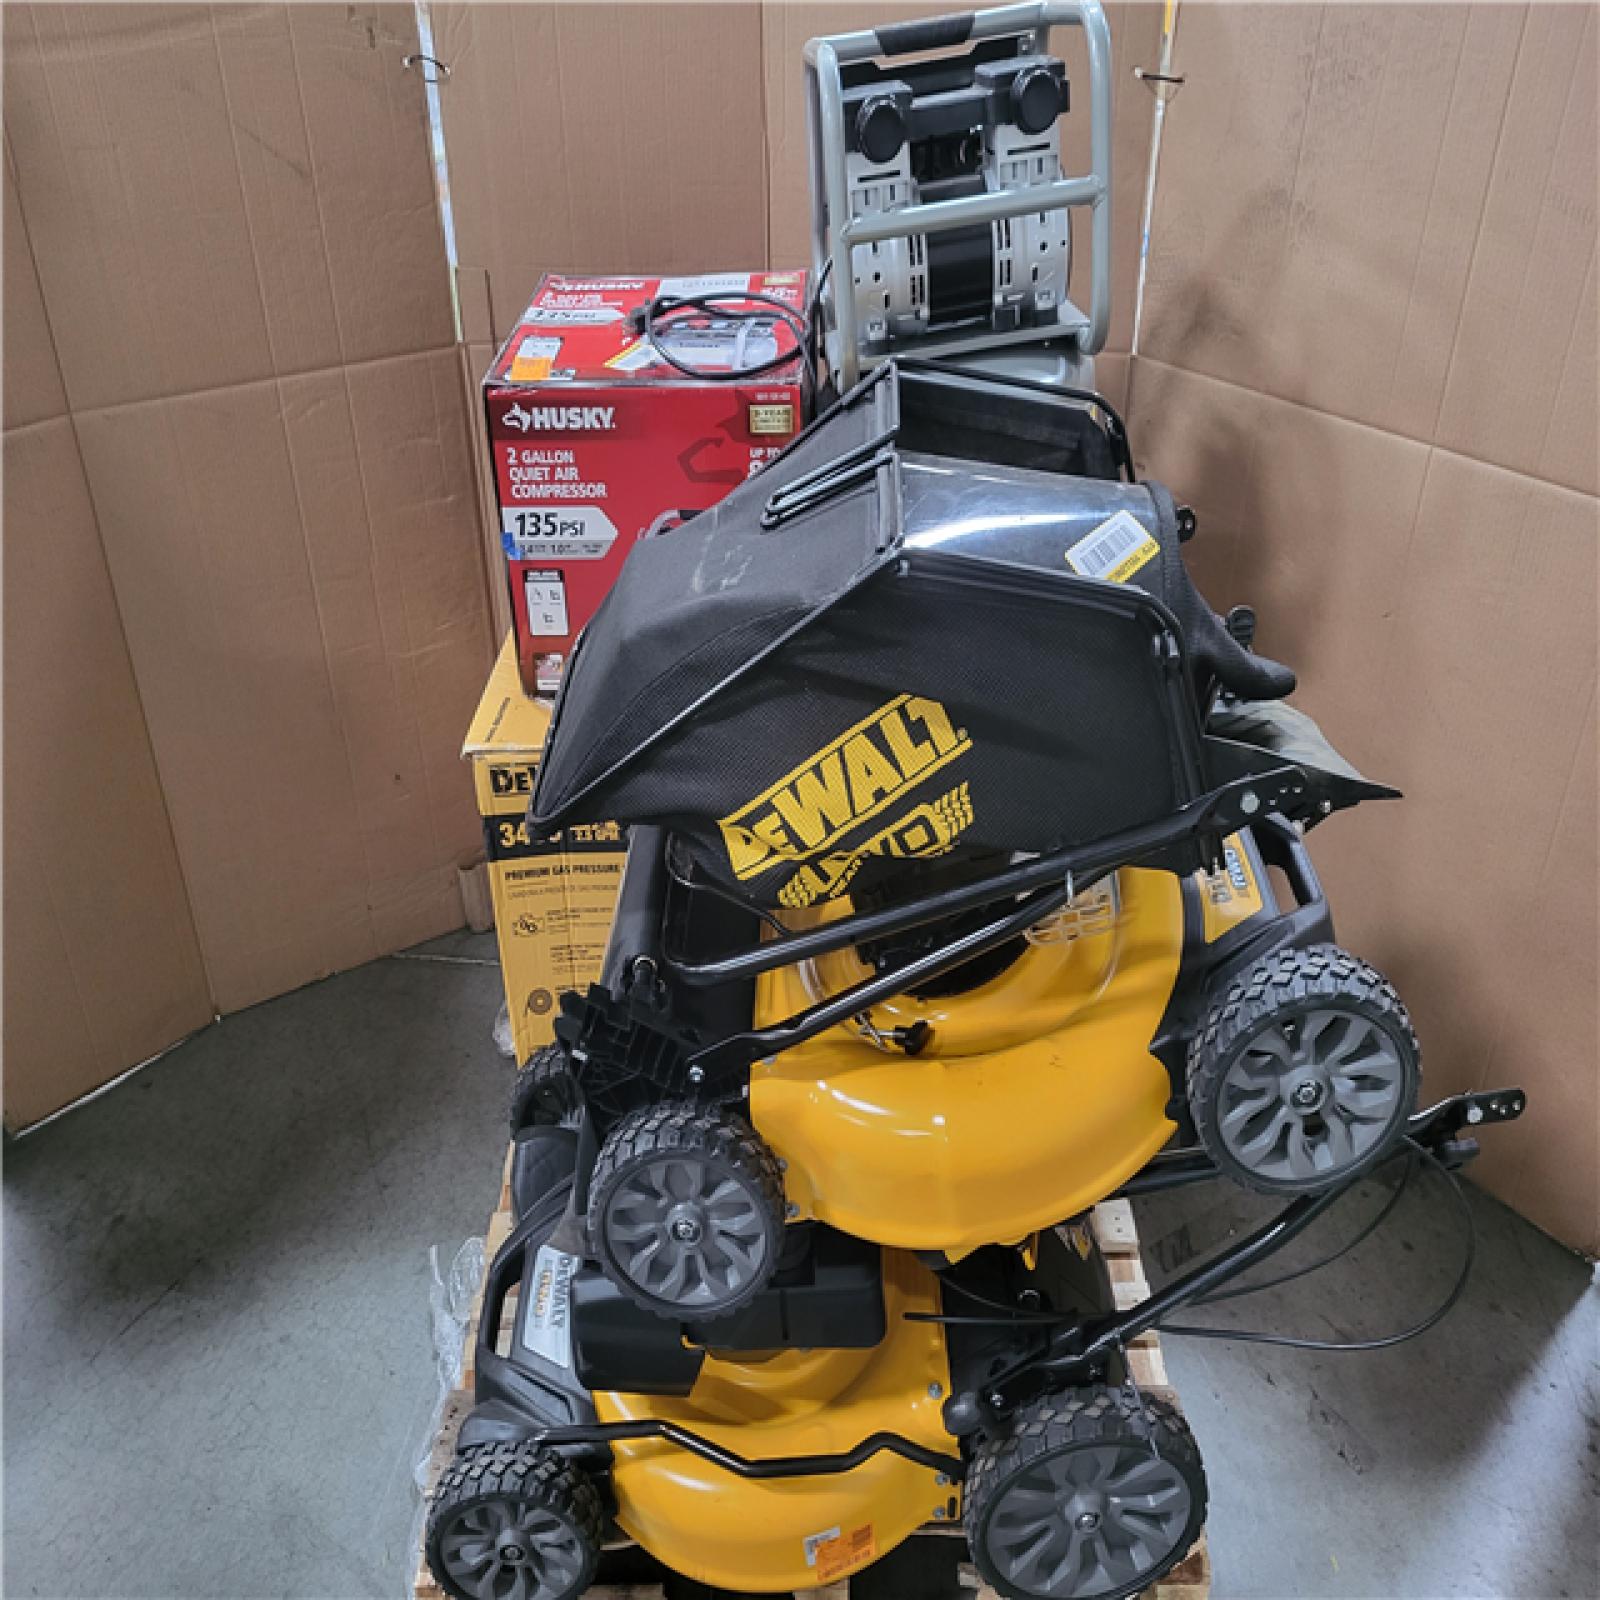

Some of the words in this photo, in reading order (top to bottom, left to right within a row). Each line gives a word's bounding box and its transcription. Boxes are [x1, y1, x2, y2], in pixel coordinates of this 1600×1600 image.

[531, 406, 615, 431] HUSKY
[506, 447, 518, 466] 2
[521, 449, 576, 464] GALLON
[509, 466, 551, 483] QUIET
[554, 466, 580, 482] AIR
[511, 482, 608, 499] COMPRESSOR
